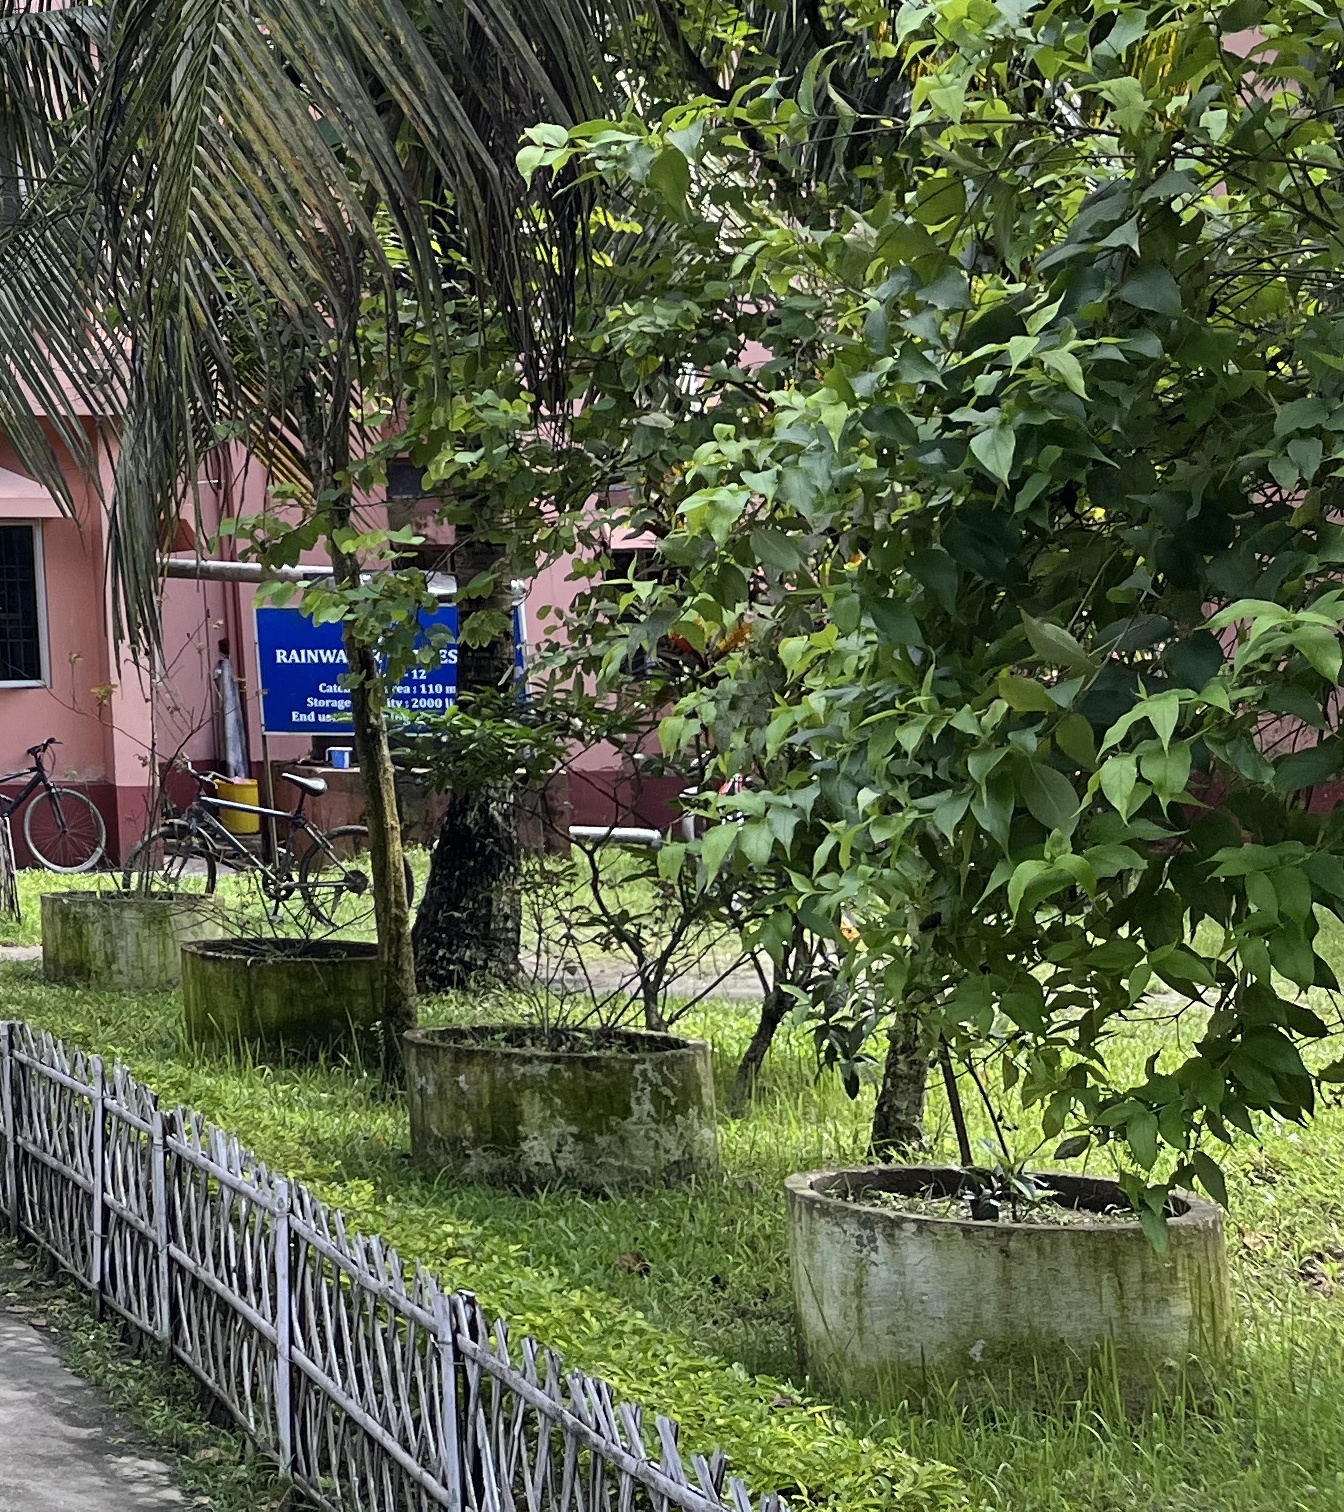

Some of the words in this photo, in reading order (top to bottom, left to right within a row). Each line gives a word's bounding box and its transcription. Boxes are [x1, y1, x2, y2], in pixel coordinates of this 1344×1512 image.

[411, 669, 427, 680] 12
[419, 683, 443, 695] 110
[306, 697, 352, 710] Storage
[411, 697, 443, 708] 2000
[291, 711, 316, 722] End
